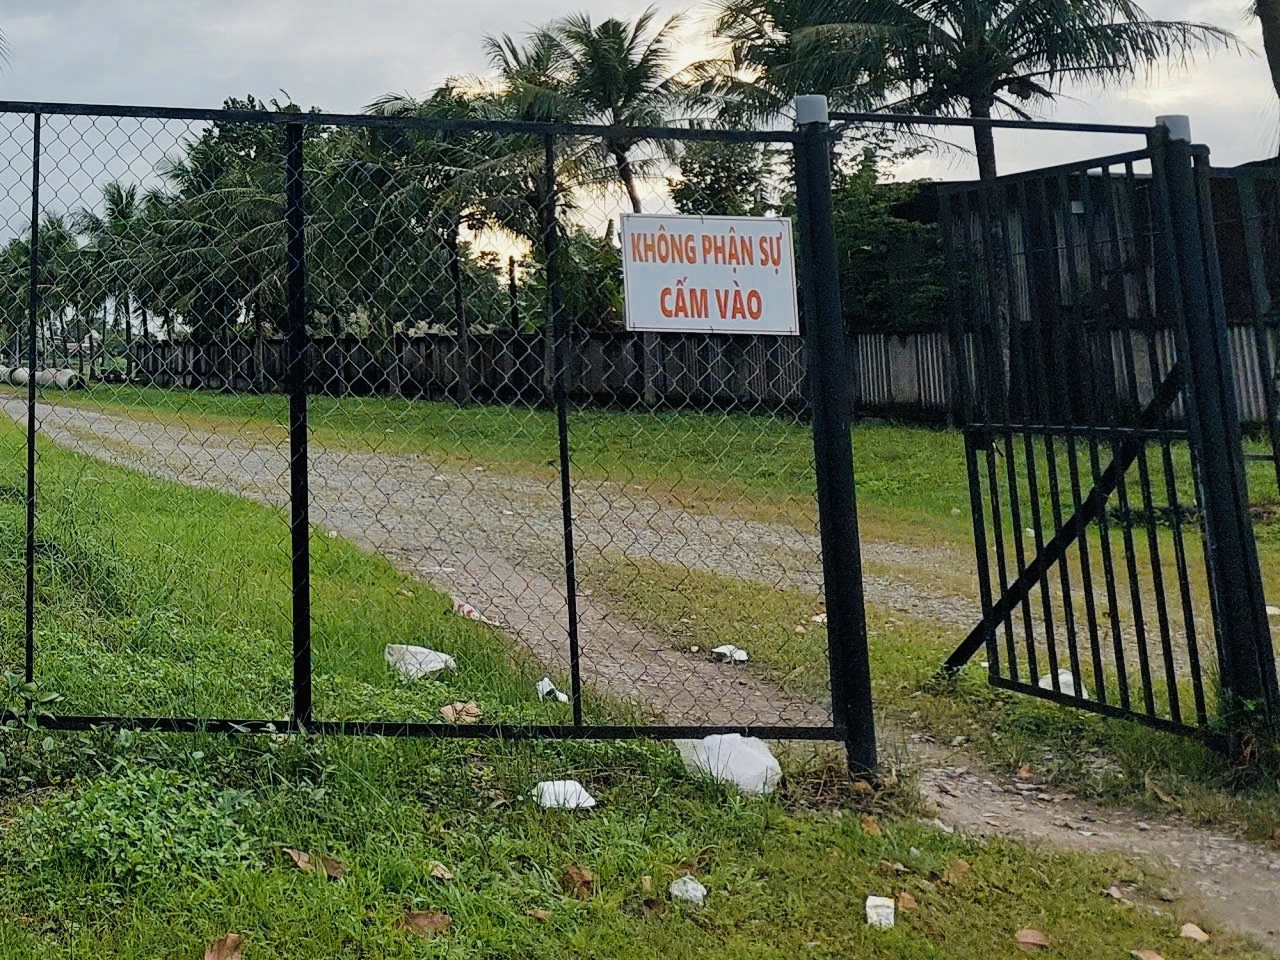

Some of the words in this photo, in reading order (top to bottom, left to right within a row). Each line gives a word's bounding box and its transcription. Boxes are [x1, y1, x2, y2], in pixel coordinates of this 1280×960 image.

[630, 224, 697, 265] KHÔNG
[701, 226, 754, 274] PHẬN
[759, 231, 783, 275] SỰ
[659, 276, 710, 319] CẤM
[714, 279, 763, 320] VÀO
